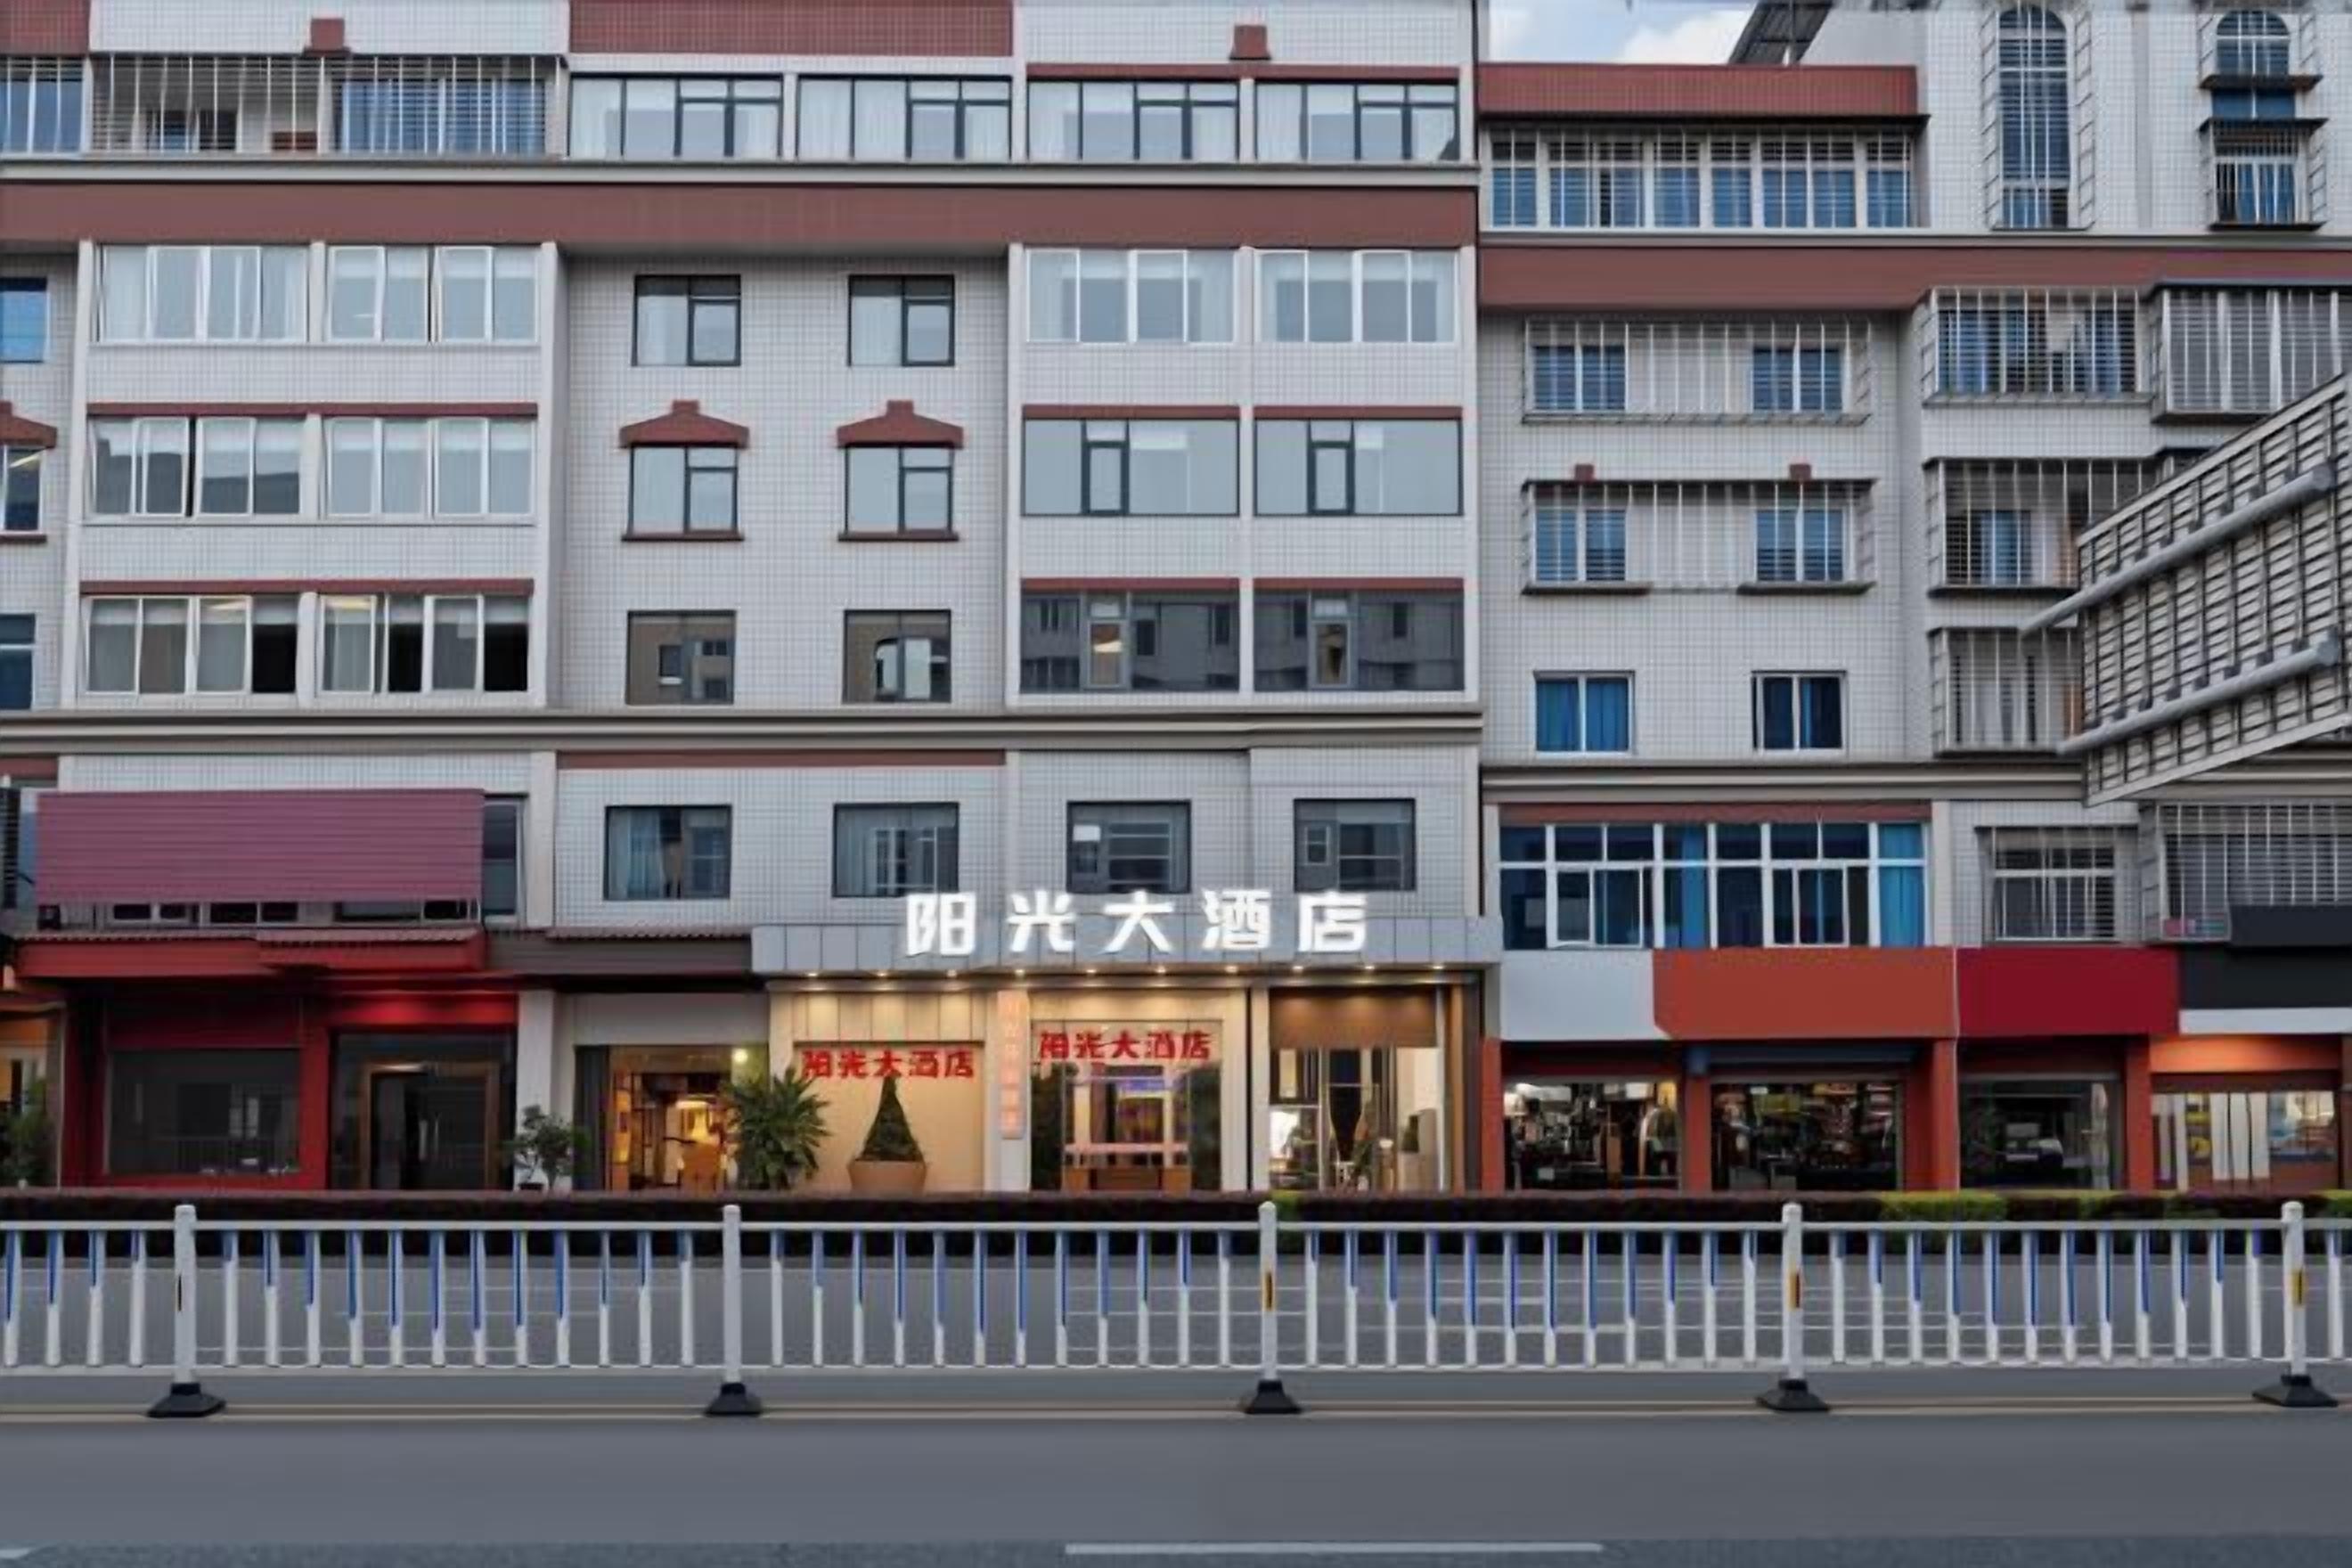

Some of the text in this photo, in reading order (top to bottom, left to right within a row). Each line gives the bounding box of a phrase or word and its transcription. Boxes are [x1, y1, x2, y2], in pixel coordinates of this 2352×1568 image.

[906, 889, 1368, 956] 阳光大酒店
[1040, 1030, 1212, 1059] 阳光大酒店
[803, 1049, 974, 1078] 阳光大酒店
